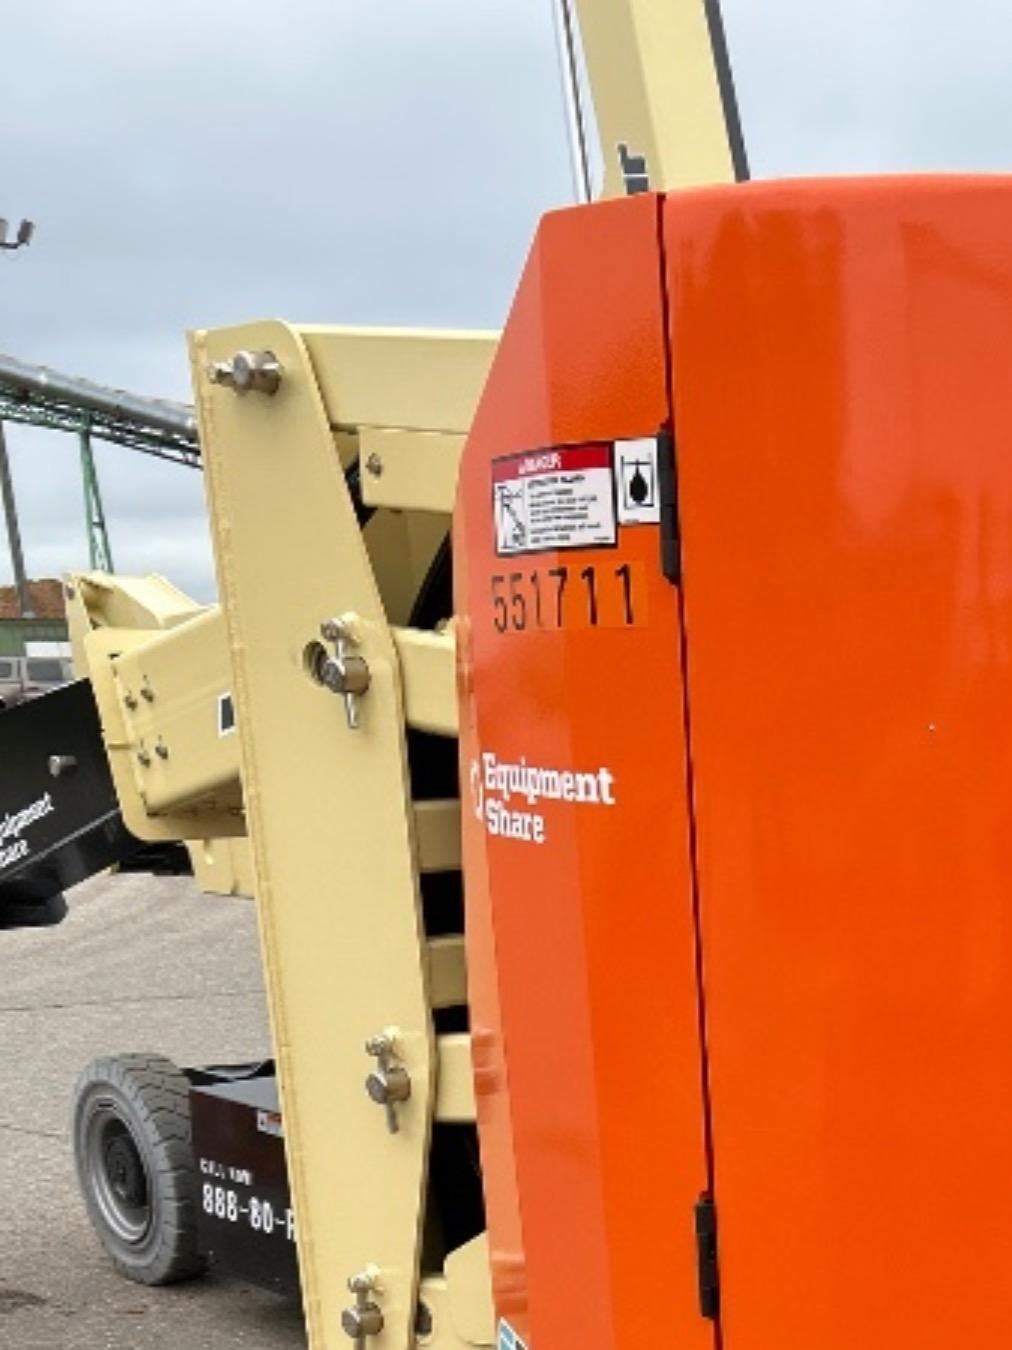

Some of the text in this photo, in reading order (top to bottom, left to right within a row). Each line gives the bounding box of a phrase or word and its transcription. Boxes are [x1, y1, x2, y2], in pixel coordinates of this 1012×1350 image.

[492, 564, 634, 634] 551711
[482, 752, 616, 805] Equipment
[485, 798, 547, 844] Share
